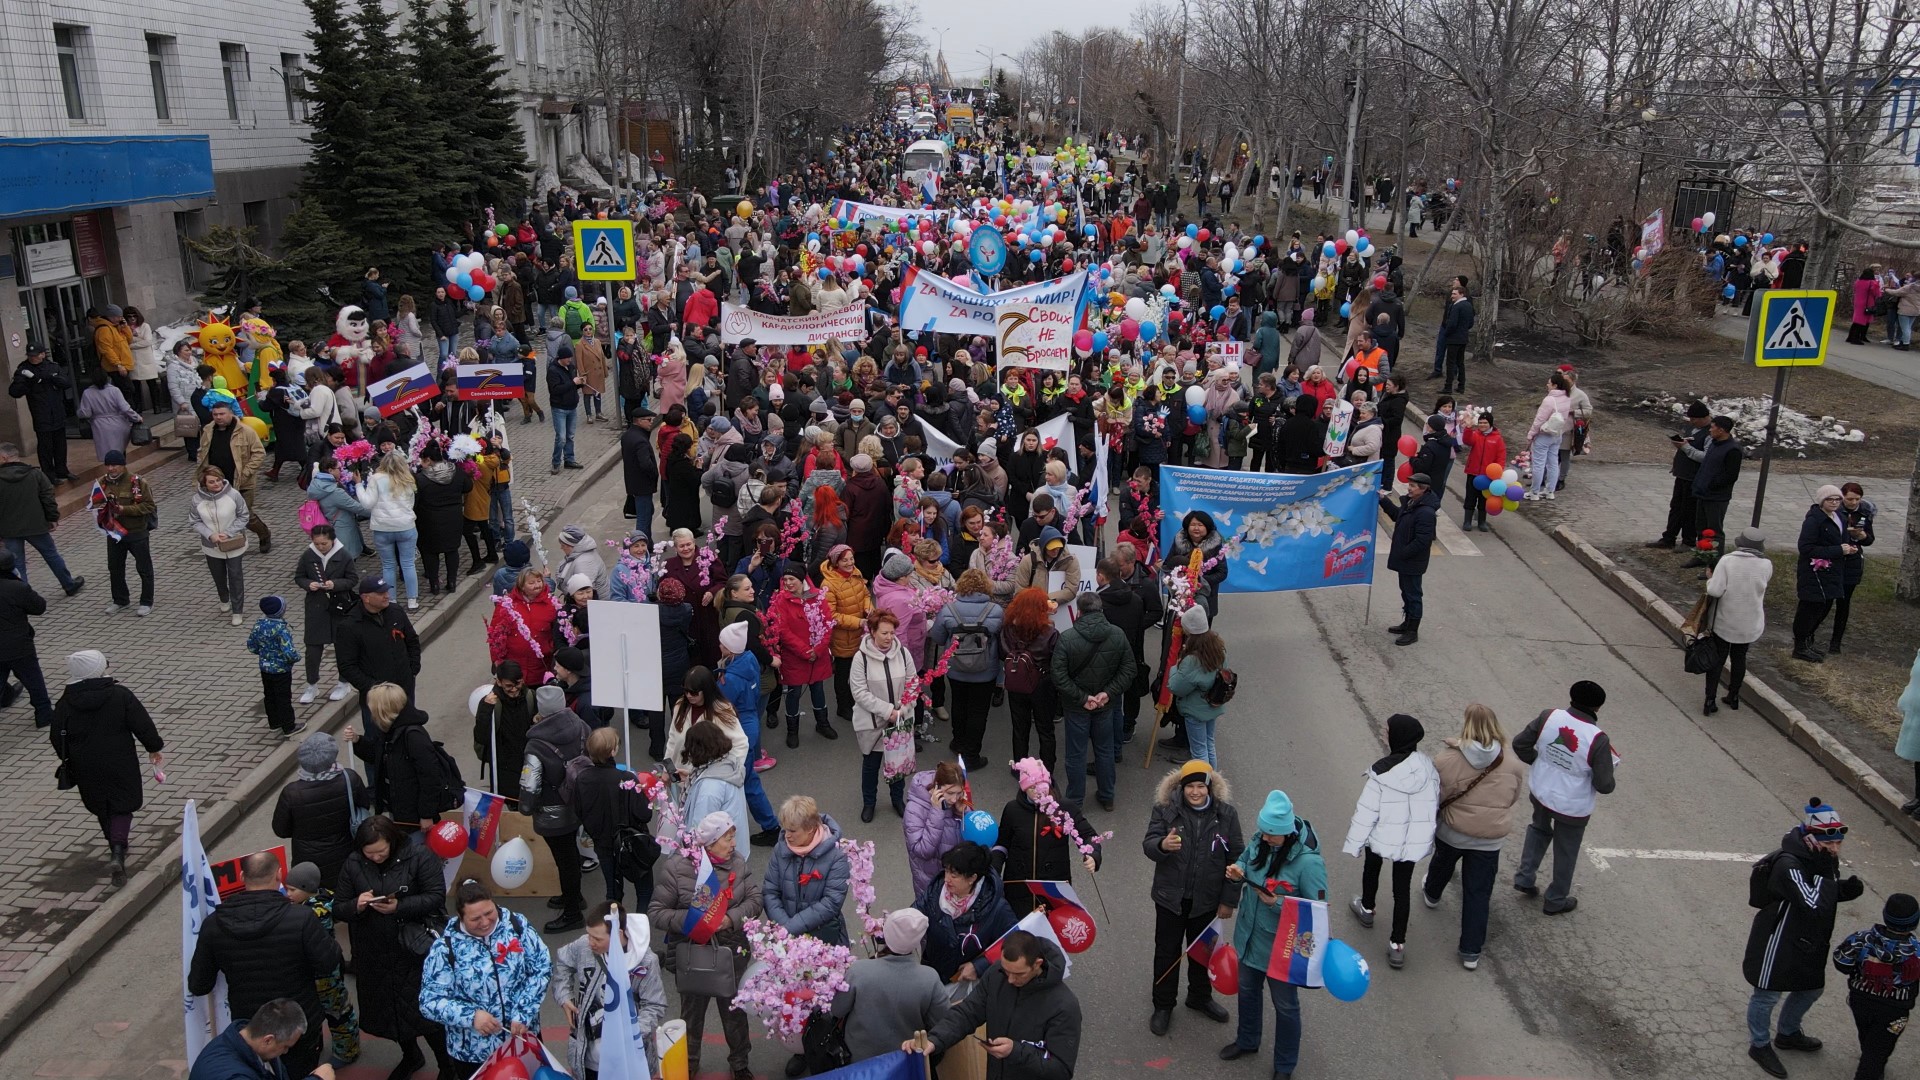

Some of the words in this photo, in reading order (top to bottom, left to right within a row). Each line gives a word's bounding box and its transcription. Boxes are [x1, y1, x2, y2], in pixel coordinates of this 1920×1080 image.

[919, 282, 938, 297] ZA
[942, 290, 1007, 308] НАШИХ!
[1035, 289, 1076, 304] МИР!
[753, 311, 819, 324] КАМЧАТСКИЙ
[821, 303, 863, 320] КРАЕВОЙ
[949, 305, 968, 318] ZA
[761, 316, 863, 331] КАРДИОЛОГИЧЕСКИЙ
[807, 329, 863, 342] ДИСПАНСЕР
[1283, 923, 1297, 959] РОССИЯ
